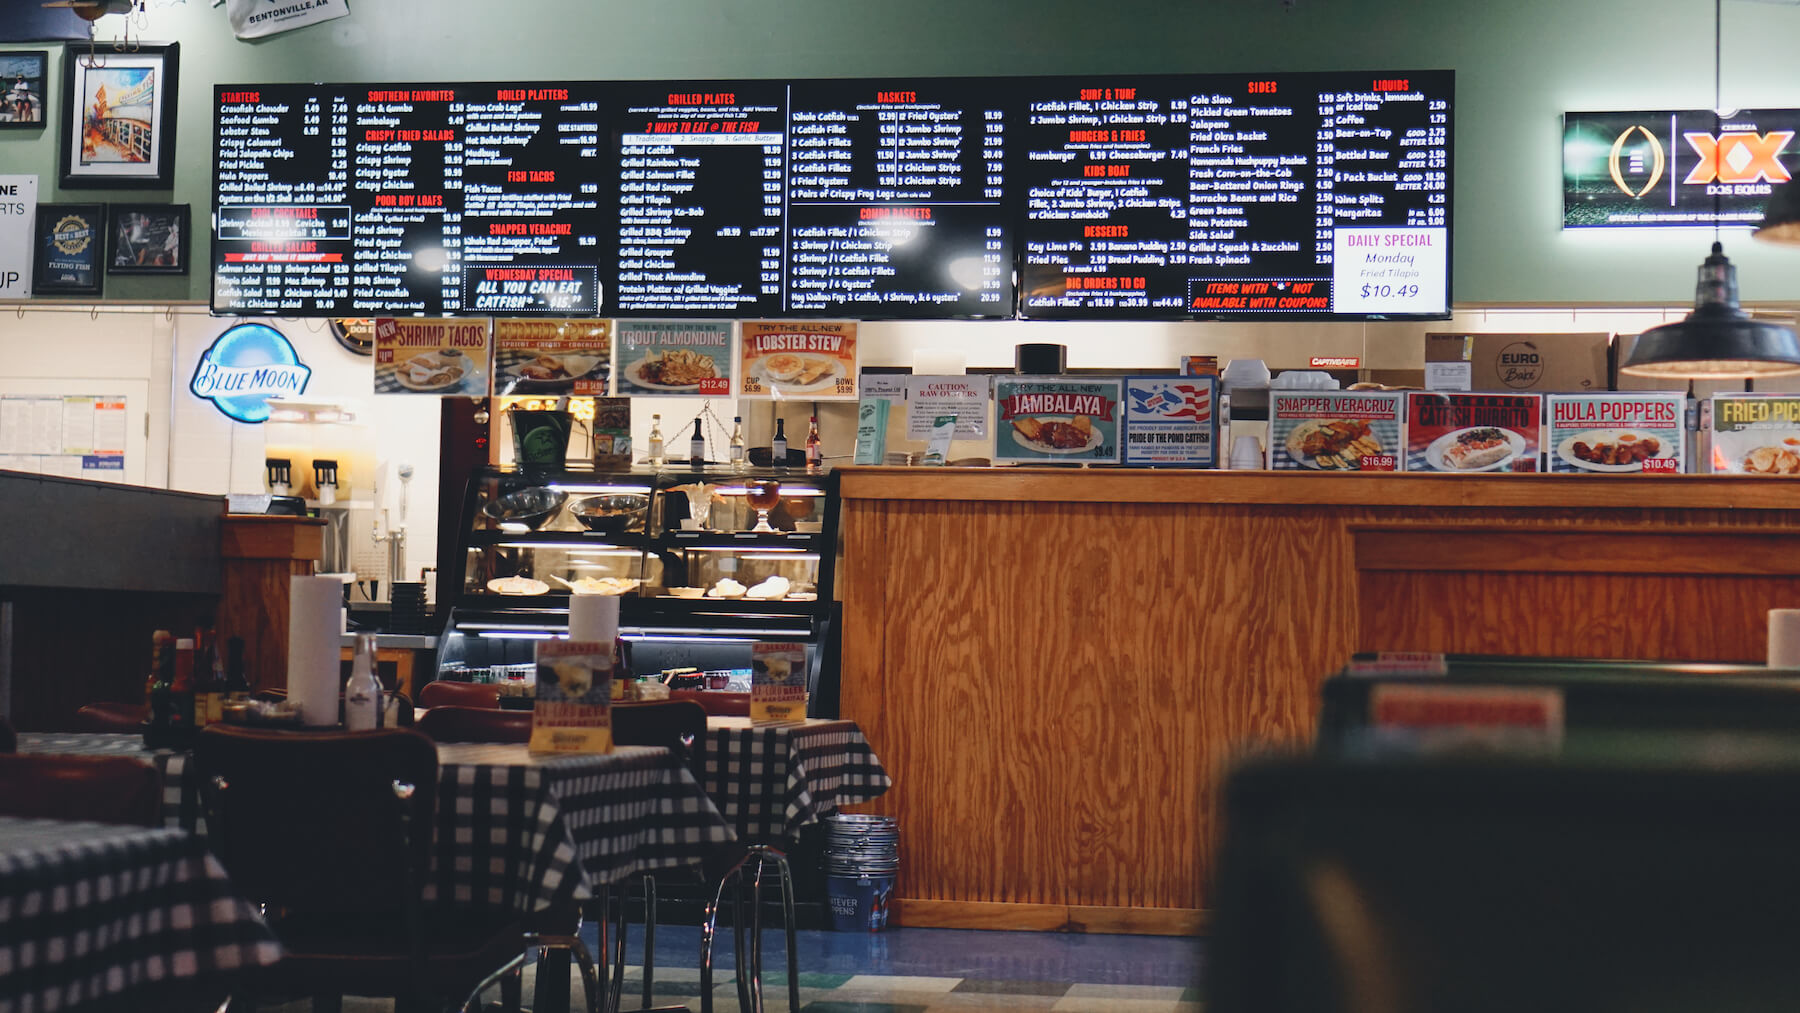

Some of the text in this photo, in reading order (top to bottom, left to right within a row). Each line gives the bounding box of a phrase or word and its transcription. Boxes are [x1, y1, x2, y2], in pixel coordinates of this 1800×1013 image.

[250, 2, 315, 23] BENTONVILLE,
[1248, 81, 1277, 93] SIDES
[1373, 80, 1408, 91] LIQUIDS
[222, 92, 259, 103] STARTERS
[368, 90, 454, 102] SOUTHERN FAVORITES
[497, 89, 568, 101] BOILED PLATTERS
[668, 93, 735, 105] GRILLED PLATES
[878, 92, 916, 103] BASKETS
[1081, 88, 1136, 100] SURF & TURF
[1191, 95, 1232, 104] Cole Slaw
[1036, 102, 1066, 111] Catfish
[1101, 101, 1135, 110] Chicken
[1138, 101, 1158, 112] Strip
[1191, 107, 1292, 116] Pickled Green Tomatoes
[1336, 115, 1364, 124] Coffee
[646, 122, 652, 133] 3
[655, 122, 678, 133] WAYS
[680, 122, 691, 133] TO
[693, 122, 709, 133] EAT
[722, 122, 738, 133] THE
[737, 122, 759, 133] FISH
[366, 130, 454, 141] CRISPY FRIED SALADS
[1070, 130, 1145, 142] BURGERS & FRIES
[1191, 131, 1267, 141] Fried Okra Basket
[1336, 129, 1391, 139] Beer-on-Tap
[1029, 151, 1075, 162] Hamburger
[508, 171, 555, 182] FISH TACOS
[1084, 165, 1130, 177] KIDS BOAT
[1707, 185, 1772, 195] DOS EQUIS
[376, 195, 442, 206] POOR BOY LOAFS
[1335, 208, 1381, 220] Margaritas
[490, 224, 571, 235] SNAPPER VERACRUZ
[1084, 225, 1128, 237] DESSERTS
[1348, 235, 1432, 246] DAILY SPECIAL
[1028, 242, 1082, 254] Key Lime Pie
[49, 262, 74, 270] FLYING
[1366, 254, 1414, 267] Monday
[486, 269, 574, 281] WEDNESDAY SPECIAL
[1389, 269, 1419, 278] Tilapia
[476, 281, 582, 294] ALL YOU CAN EAT
[1065, 277, 1145, 290] BIG ORDERS TO GO
[1206, 283, 1314, 294] ITEMS WITH NOT
[1360, 284, 1418, 298] $10.49
[1192, 297, 1328, 308] AVAILABLE WITH COUPONS
[378, 321, 396, 338] NEW
[501, 322, 558, 340] FRIED
[399, 325, 445, 346] SHRIMP
[448, 325, 484, 346] TACOS
[621, 331, 727, 346] TROUT ALMONDINE
[756, 335, 842, 351] LOBSTER STEW
[1502, 353, 1538, 364] EURO
[252, 369, 299, 390] MOON
[701, 381, 728, 389] $12.49
[744, 384, 761, 392] $6.99
[1037, 384, 1056, 392] THE
[1059, 384, 1075, 392] ALL
[1014, 395, 1100, 414] JAMBALAYA
[1277, 399, 1395, 412] SNAPPER VERACRUZ
[1555, 403, 1675, 420] HULA POPPERS
[1724, 402, 1800, 422] FRIED PIC
[1475, 408, 1528, 428] BURRITO
[1129, 433, 1210, 443] PRIDE OF THE POND CATFISH
[1362, 456, 1393, 466] $16.99
[1644, 460, 1675, 469] $10.49
